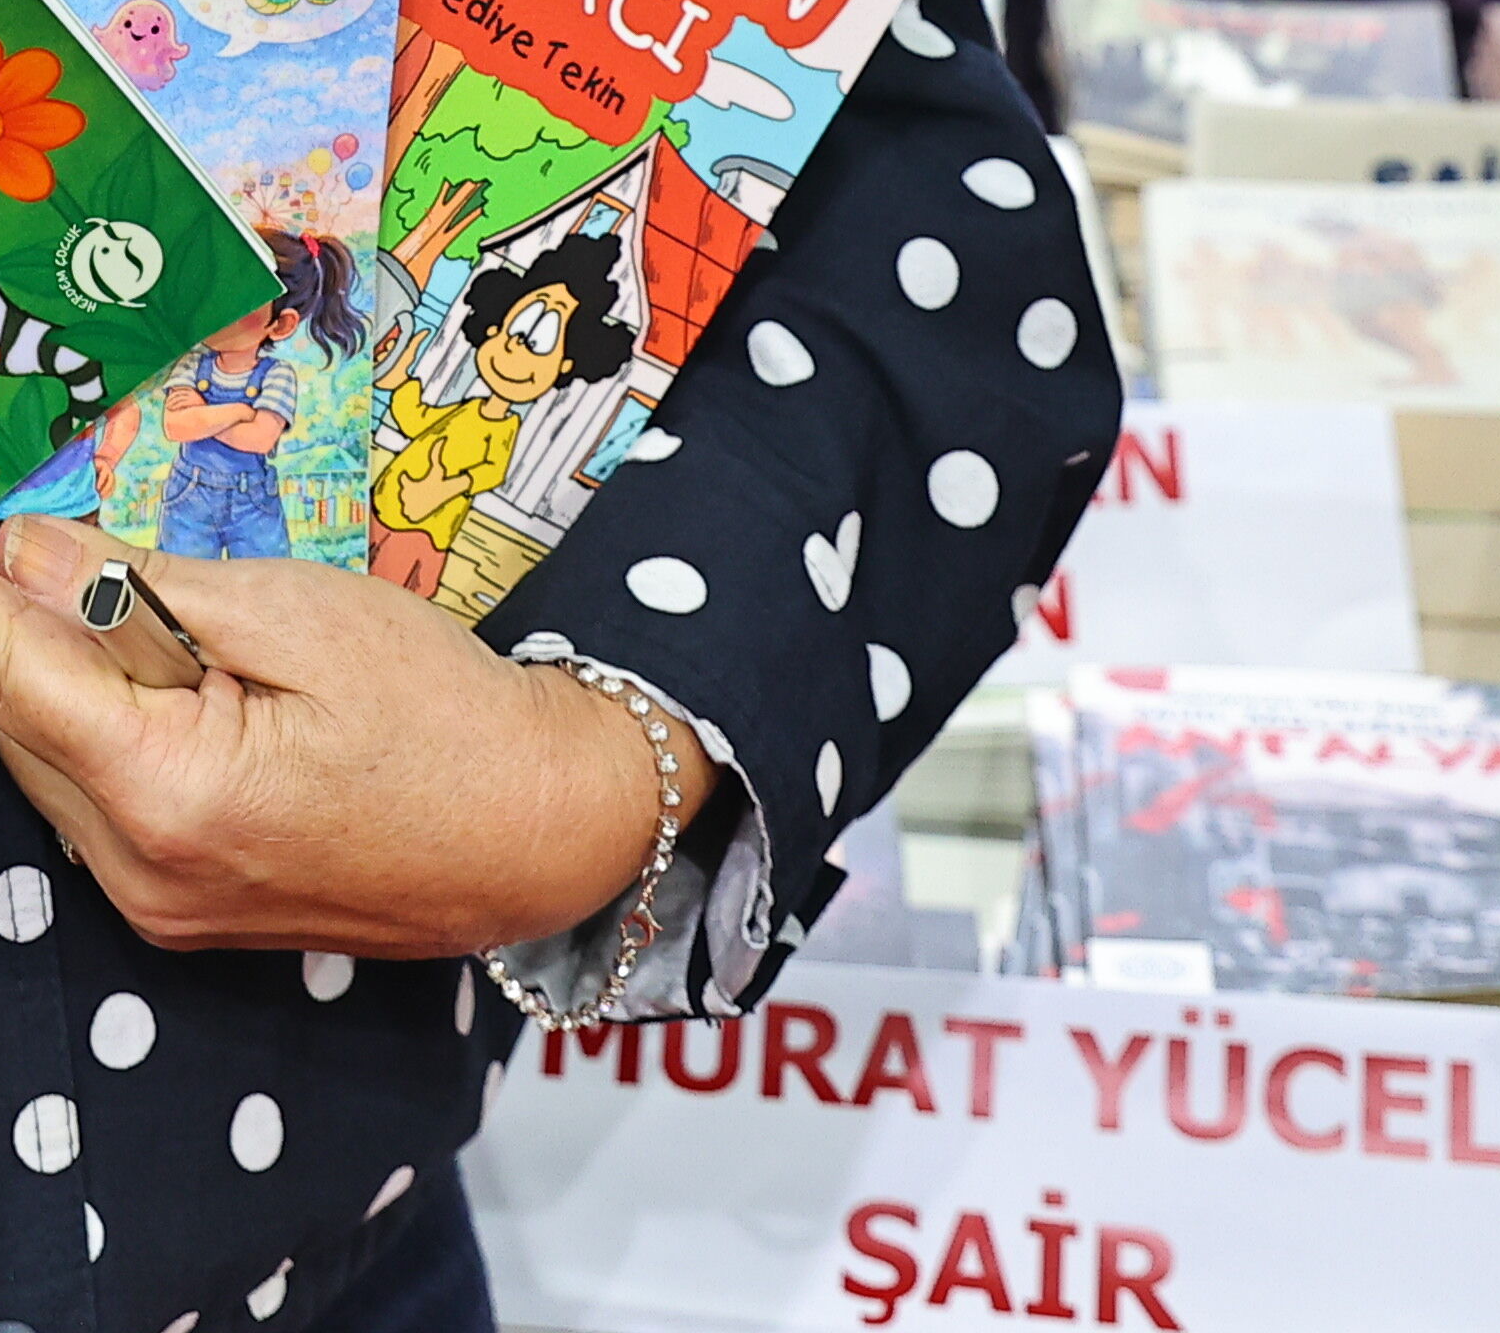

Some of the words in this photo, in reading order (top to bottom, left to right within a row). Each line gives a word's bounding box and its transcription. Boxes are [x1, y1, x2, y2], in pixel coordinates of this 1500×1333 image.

[541, 40, 627, 116] Tekin
[538, 1002, 1024, 1119] MURAT
[840, 1189, 1184, 1332] ŞAİR
